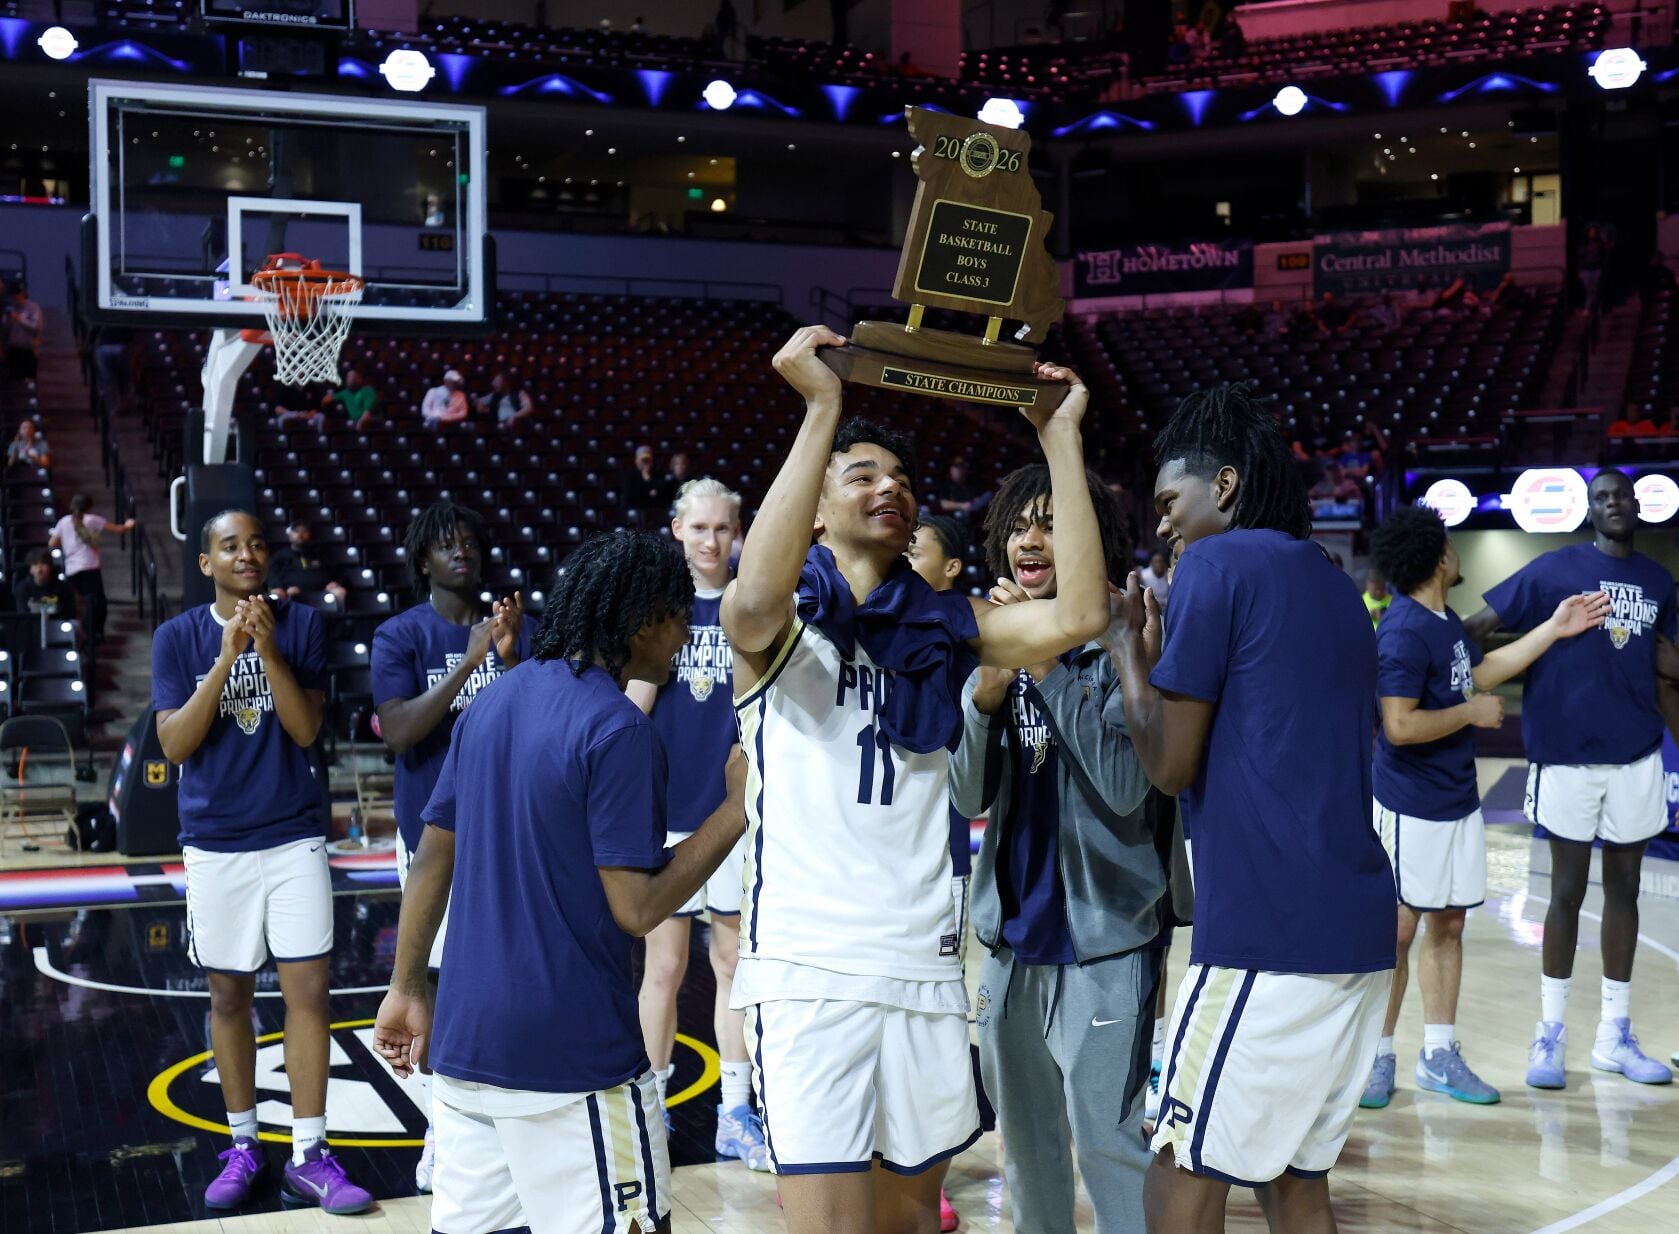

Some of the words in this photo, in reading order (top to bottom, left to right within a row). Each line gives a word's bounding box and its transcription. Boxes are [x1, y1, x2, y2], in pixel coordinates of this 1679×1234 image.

[243, 10, 317, 24] DAKTRONICS
[934, 136, 960, 160] 20
[996, 150, 1021, 172] 26
[962, 219, 998, 235] STATE
[939, 233, 1013, 256] BASKETBALL
[956, 254, 987, 269] BOYS
[1321, 249, 1391, 271] Central
[1399, 243, 1501, 267] Methodist
[945, 271, 982, 287] CLASS
[982, 277, 990, 288] 3
[904, 374, 946, 391] STATE
[948, 381, 1020, 401] CHAMPIONS
[1600, 585, 1643, 602] STATE
[1609, 598, 1658, 625] MPIONS
[1599, 615, 1642, 636] RINCIPIA
[690, 630, 729, 646] TATE
[671, 644, 733, 668] HAMPION
[220, 695, 274, 718] PRINCIPIA
[856, 724, 895, 806] 11
[1166, 1096, 1194, 1130] P
[614, 1181, 642, 1212] P
